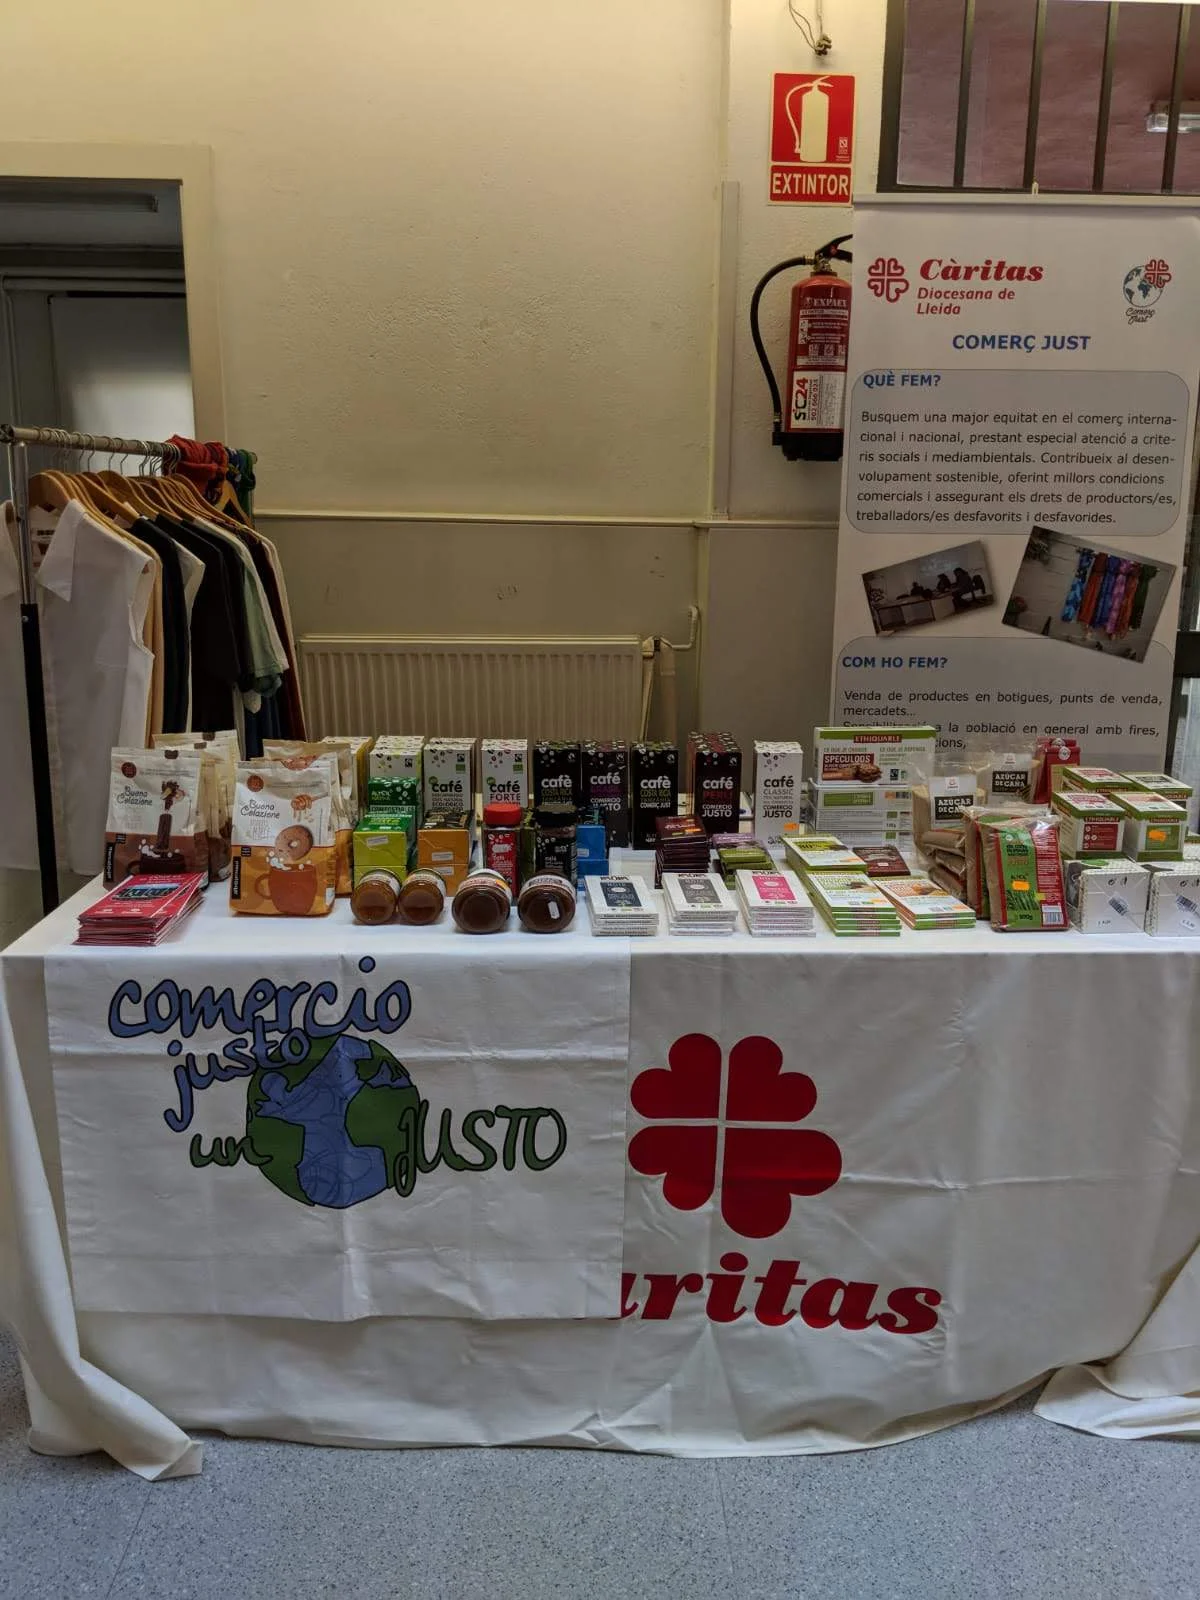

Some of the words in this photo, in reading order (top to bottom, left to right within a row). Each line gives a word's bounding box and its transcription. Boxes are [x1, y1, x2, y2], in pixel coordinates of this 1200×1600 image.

[772, 173, 849, 195] EXTINTOR
[919, 258, 1044, 281] Càritas
[918, 287, 993, 300] Diocesana
[998, 288, 1015, 300] de
[917, 302, 961, 315] Lleida
[952, 335, 1036, 353] COMERÇ
[1041, 336, 1091, 350] JUST
[863, 370, 894, 388] QUÈ
[901, 375, 941, 387] FEM?
[862, 411, 919, 424] Busquem
[924, 414, 946, 422] una
[952, 412, 989, 425] major
[993, 412, 1038, 424] equitat
[1042, 414, 1057, 423] en
[1062, 412, 1073, 423] el
[1077, 415, 1123, 427] comerç
[1128, 414, 1177, 425] interna-
[860, 432, 896, 442] cional
[901, 432, 904, 442] i
[909, 432, 964, 445] nacional,
[969, 433, 1022, 445] prestant
[1026, 433, 1077, 445] especial
[1081, 432, 1126, 444] atenció
[1131, 436, 1138, 444] a
[1143, 434, 1175, 445] crite-
[859, 451, 874, 462] ris
[879, 451, 920, 462] socials
[924, 451, 928, 462] i
[932, 452, 1035, 463] mediambientals.
[1041, 452, 1112, 464] Contribueix
[1117, 453, 1128, 464] al
[1132, 453, 1174, 464] desen-
[859, 471, 932, 484] volupament
[936, 472, 1002, 484] sostenible,
[1008, 472, 1049, 483] oferint
[1054, 472, 1095, 484] millors
[1099, 473, 1164, 484] condicions
[857, 491, 923, 502] comercials
[927, 491, 930, 501] i
[935, 492, 1004, 504] assegurant
[1008, 491, 1026, 502] els
[1030, 492, 1062, 503] drets
[1067, 492, 1082, 503] de
[1086, 493, 1176, 506] productors/es,
[856, 510, 949, 522] treballadors/es
[954, 511, 1022, 522] desfavorits
[1026, 512, 1030, 522] i
[1034, 512, 1115, 523] desfavorides.
[843, 657, 876, 668] COM
[881, 657, 903, 668] HO
[909, 657, 948, 668] FEM?
[844, 691, 881, 700] Venda
[888, 691, 902, 701] de
[909, 691, 969, 703] productes
[975, 693, 990, 702] en
[997, 692, 1052, 704] botigues,
[1060, 694, 1093, 704] punts
[1100, 694, 1115, 703] de
[1122, 694, 1162, 706] venda,
[844, 706, 916, 716] mercadets...
[935, 725, 942, 733] a
[949, 723, 959, 733] la
[1022, 725, 1037, 734] en
[1096, 725, 1122, 735] amb
[1129, 726, 1159, 737] fires,
[824, 755, 871, 763] SPECULOOS
[542, 776, 572, 788] cafè
[591, 772, 620, 785] café
[640, 776, 671, 788] cafè
[703, 777, 733, 789] café
[764, 776, 794, 788] café
[432, 781, 462, 792] café
[490, 782, 520, 792] café
[702, 809, 732, 817] JUSTO
[763, 809, 792, 818] JUSTO
[109, 957, 411, 1037] comercio
[163, 1015, 310, 1132] justo
[190, 1133, 272, 1167] un
[608, 1252, 942, 1334] ritas
